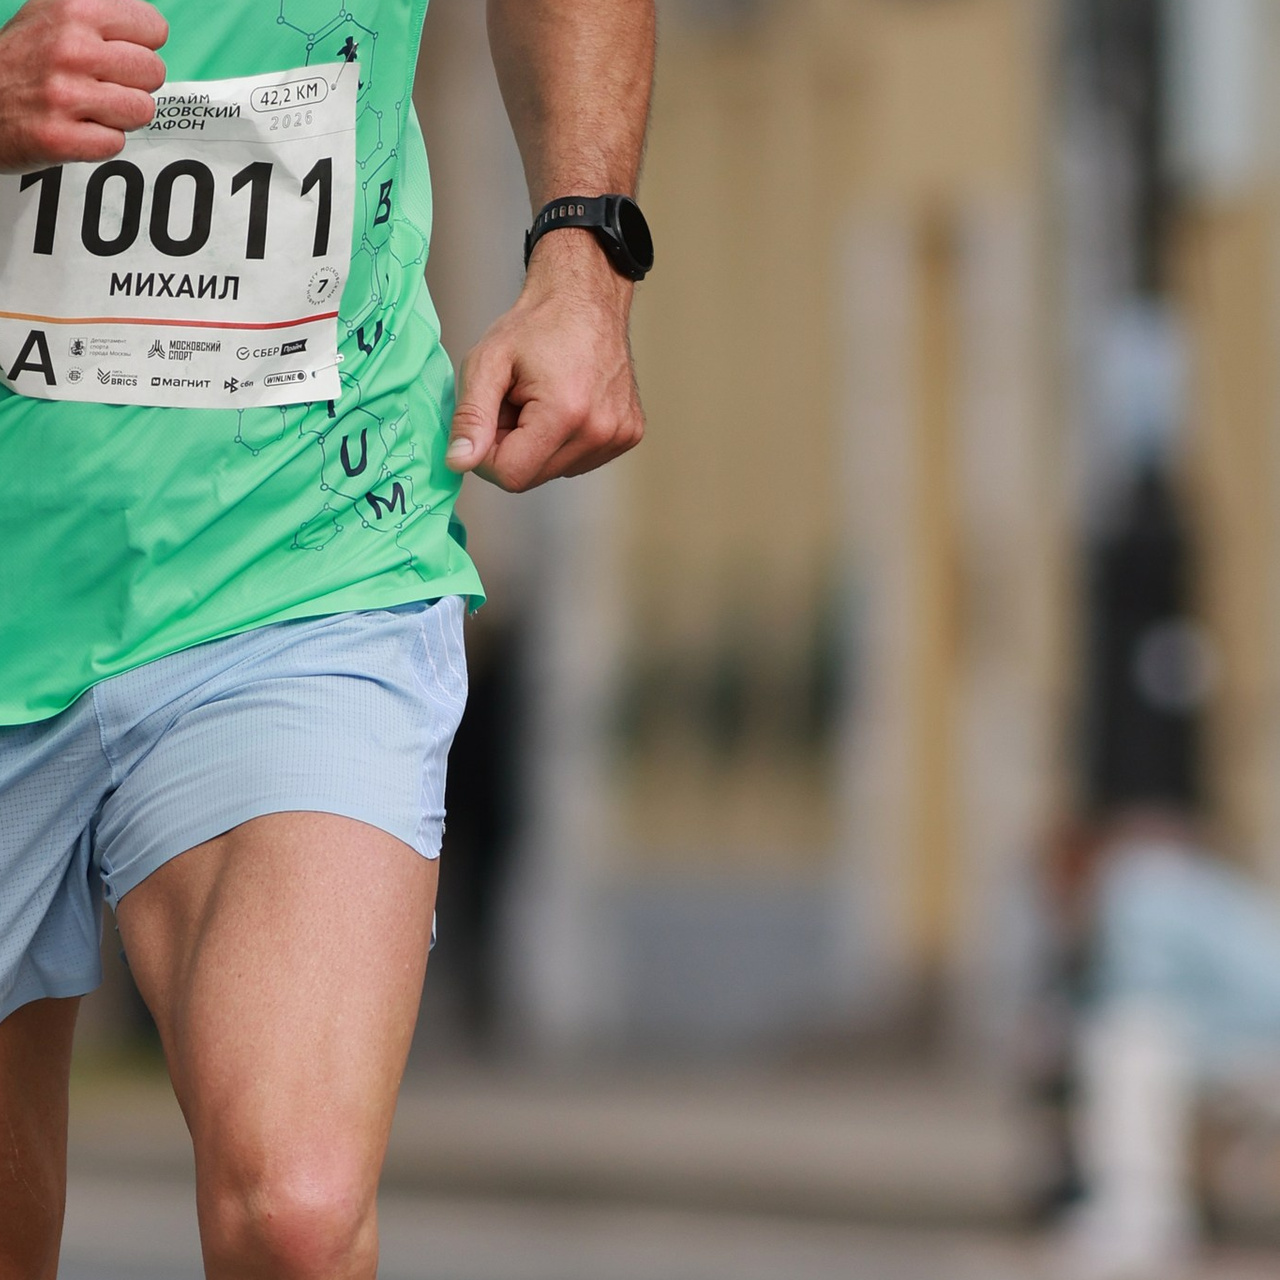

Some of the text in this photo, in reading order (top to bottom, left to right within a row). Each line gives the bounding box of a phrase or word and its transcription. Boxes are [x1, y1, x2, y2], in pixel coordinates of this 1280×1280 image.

[157, 93, 210, 106] ПРАЙМ
[260, 87, 292, 106] 42,2
[156, 102, 241, 119] КОВСКИЙ
[147, 119, 206, 131] АФОН
[269, 109, 313, 131] 2026
[19, 158, 333, 260] 10011
[109, 272, 240, 300] МИХАИЛ
[317, 278, 329, 293] 7
[169, 339, 221, 353] МОСКОВСКИЙ
[253, 346, 280, 358] СБЕР
[168, 350, 192, 361] СПОРТ
[111, 377, 138, 387] BRICS
[267, 373, 296, 384] WINLINE
